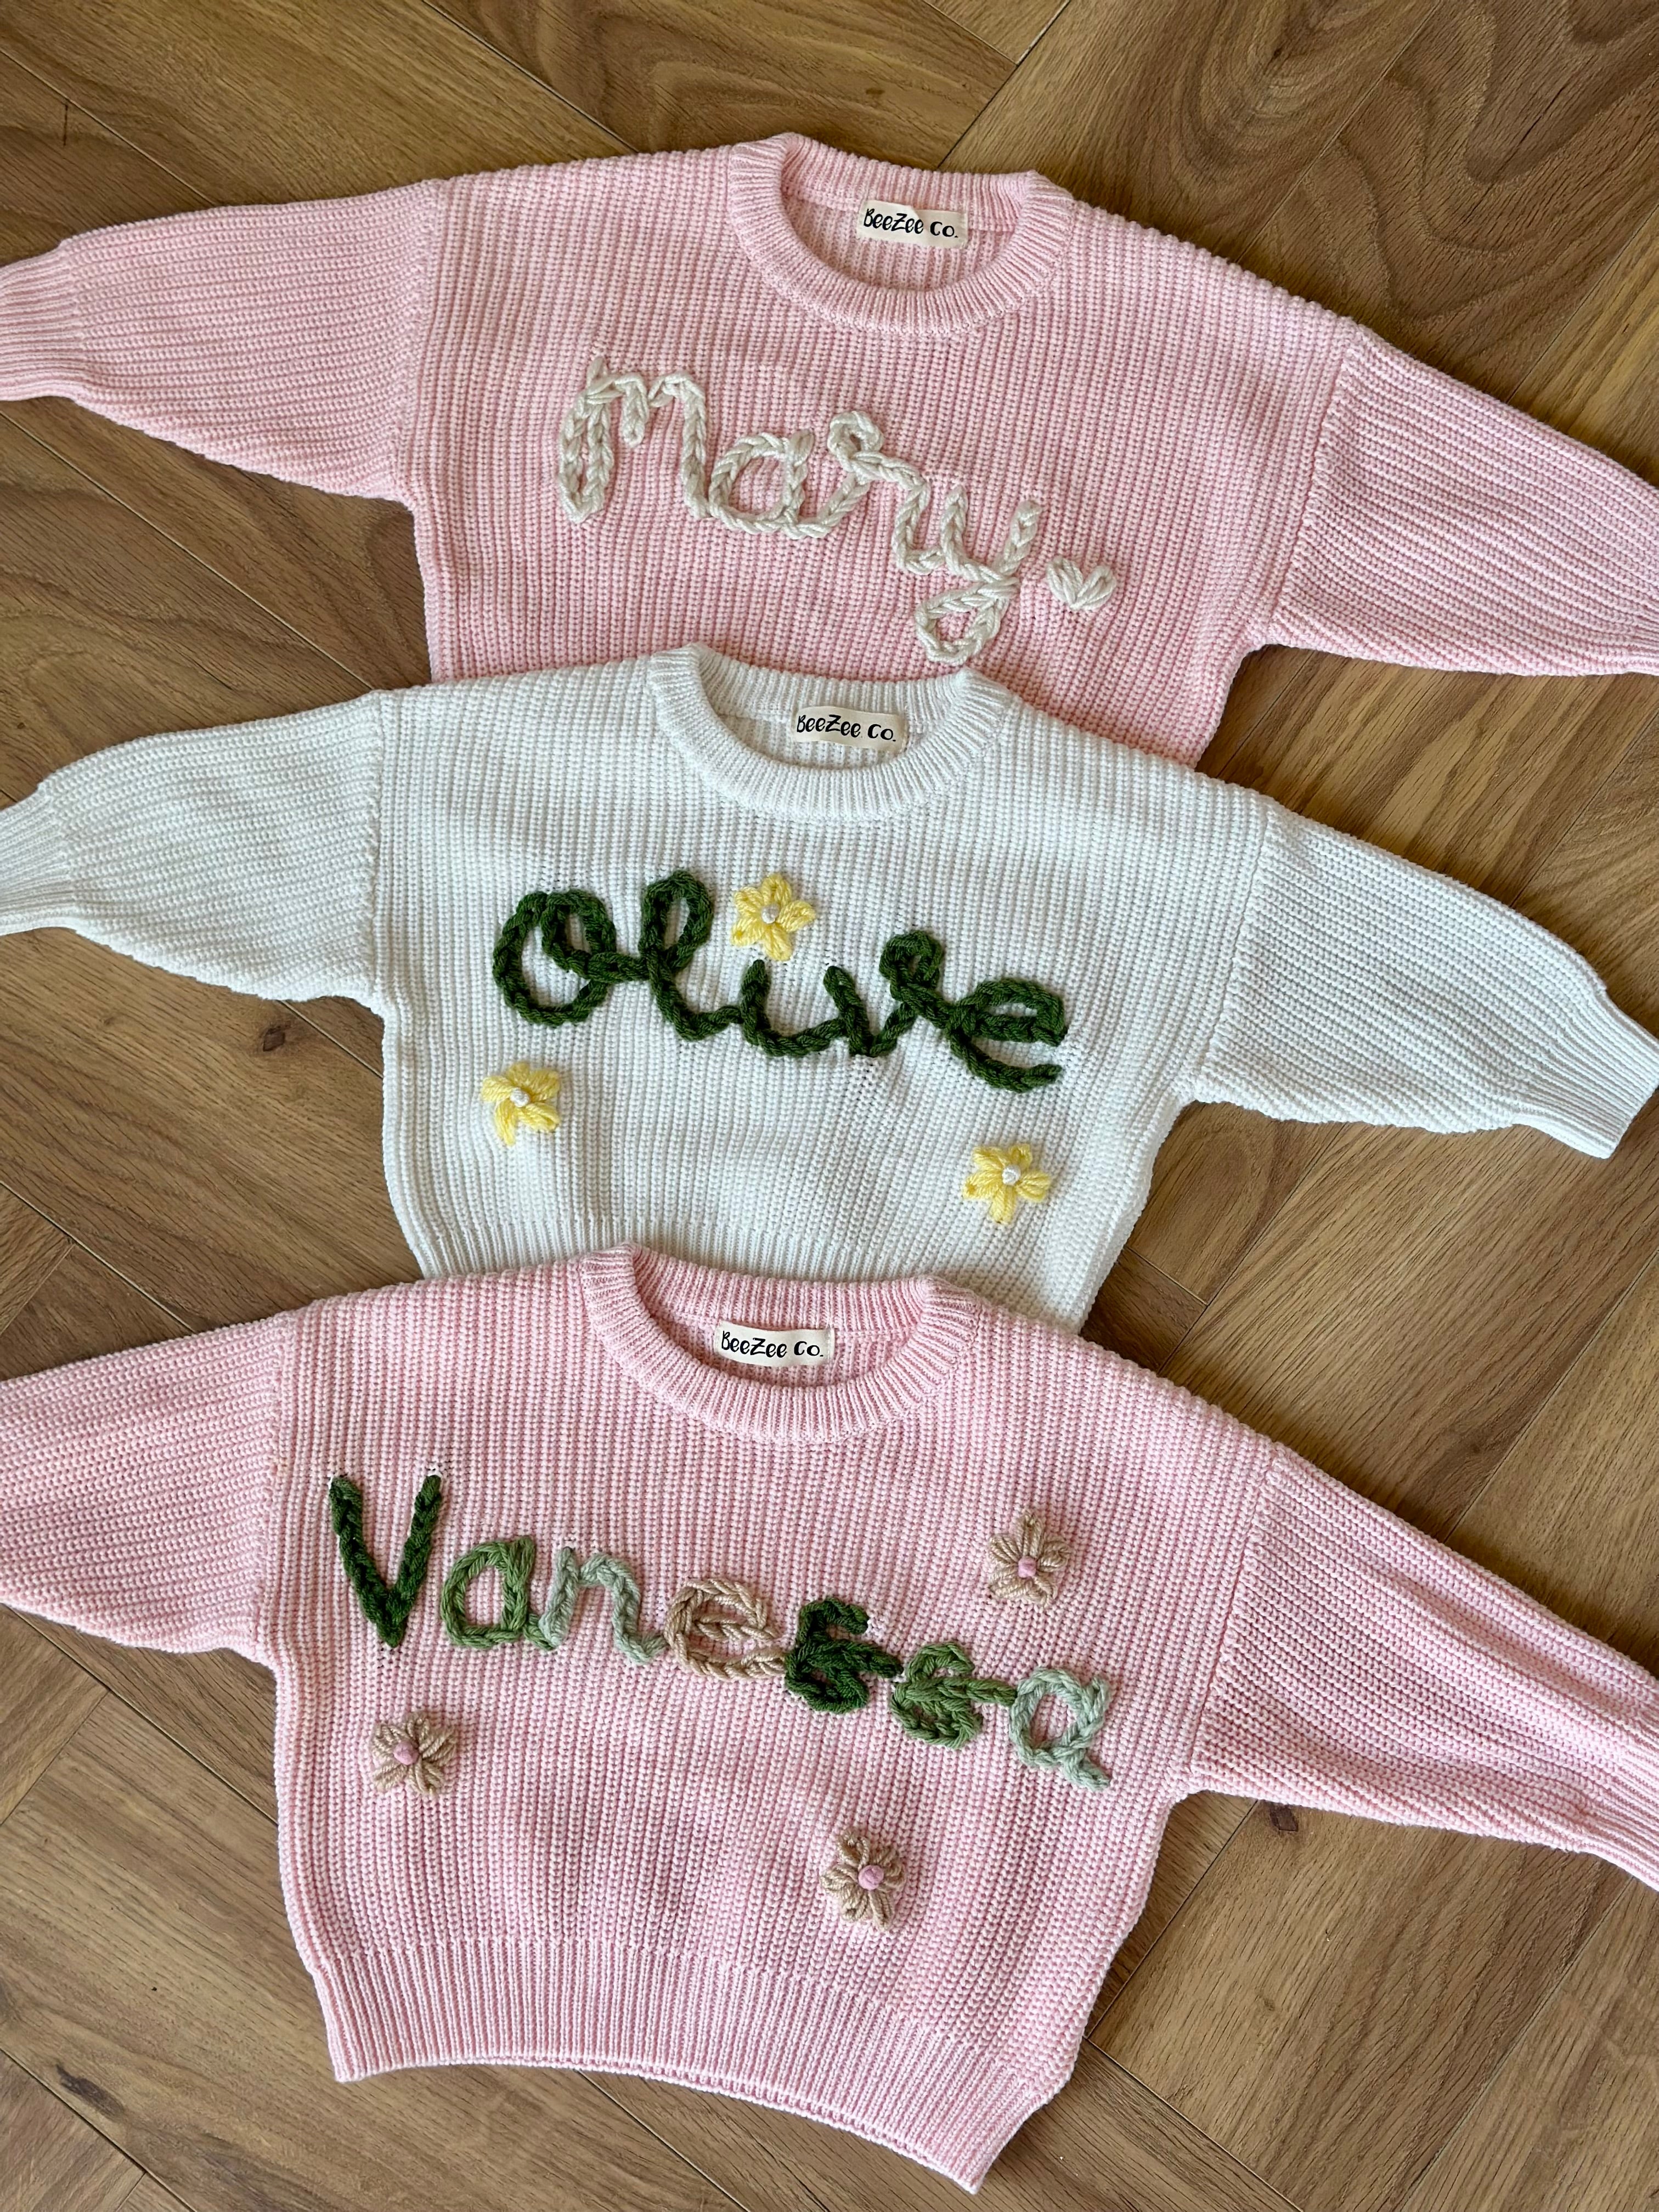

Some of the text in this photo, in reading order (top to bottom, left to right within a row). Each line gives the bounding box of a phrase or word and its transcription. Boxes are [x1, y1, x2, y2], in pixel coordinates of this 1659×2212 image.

[863, 208, 958, 238] BeeZee Co.
[559, 354, 1043, 665] Mary
[796, 714, 896, 742] BeeZee Co.
[721, 1330, 824, 1358] BeeZee Co.
[329, 1474, 1113, 1791] Vanessa
